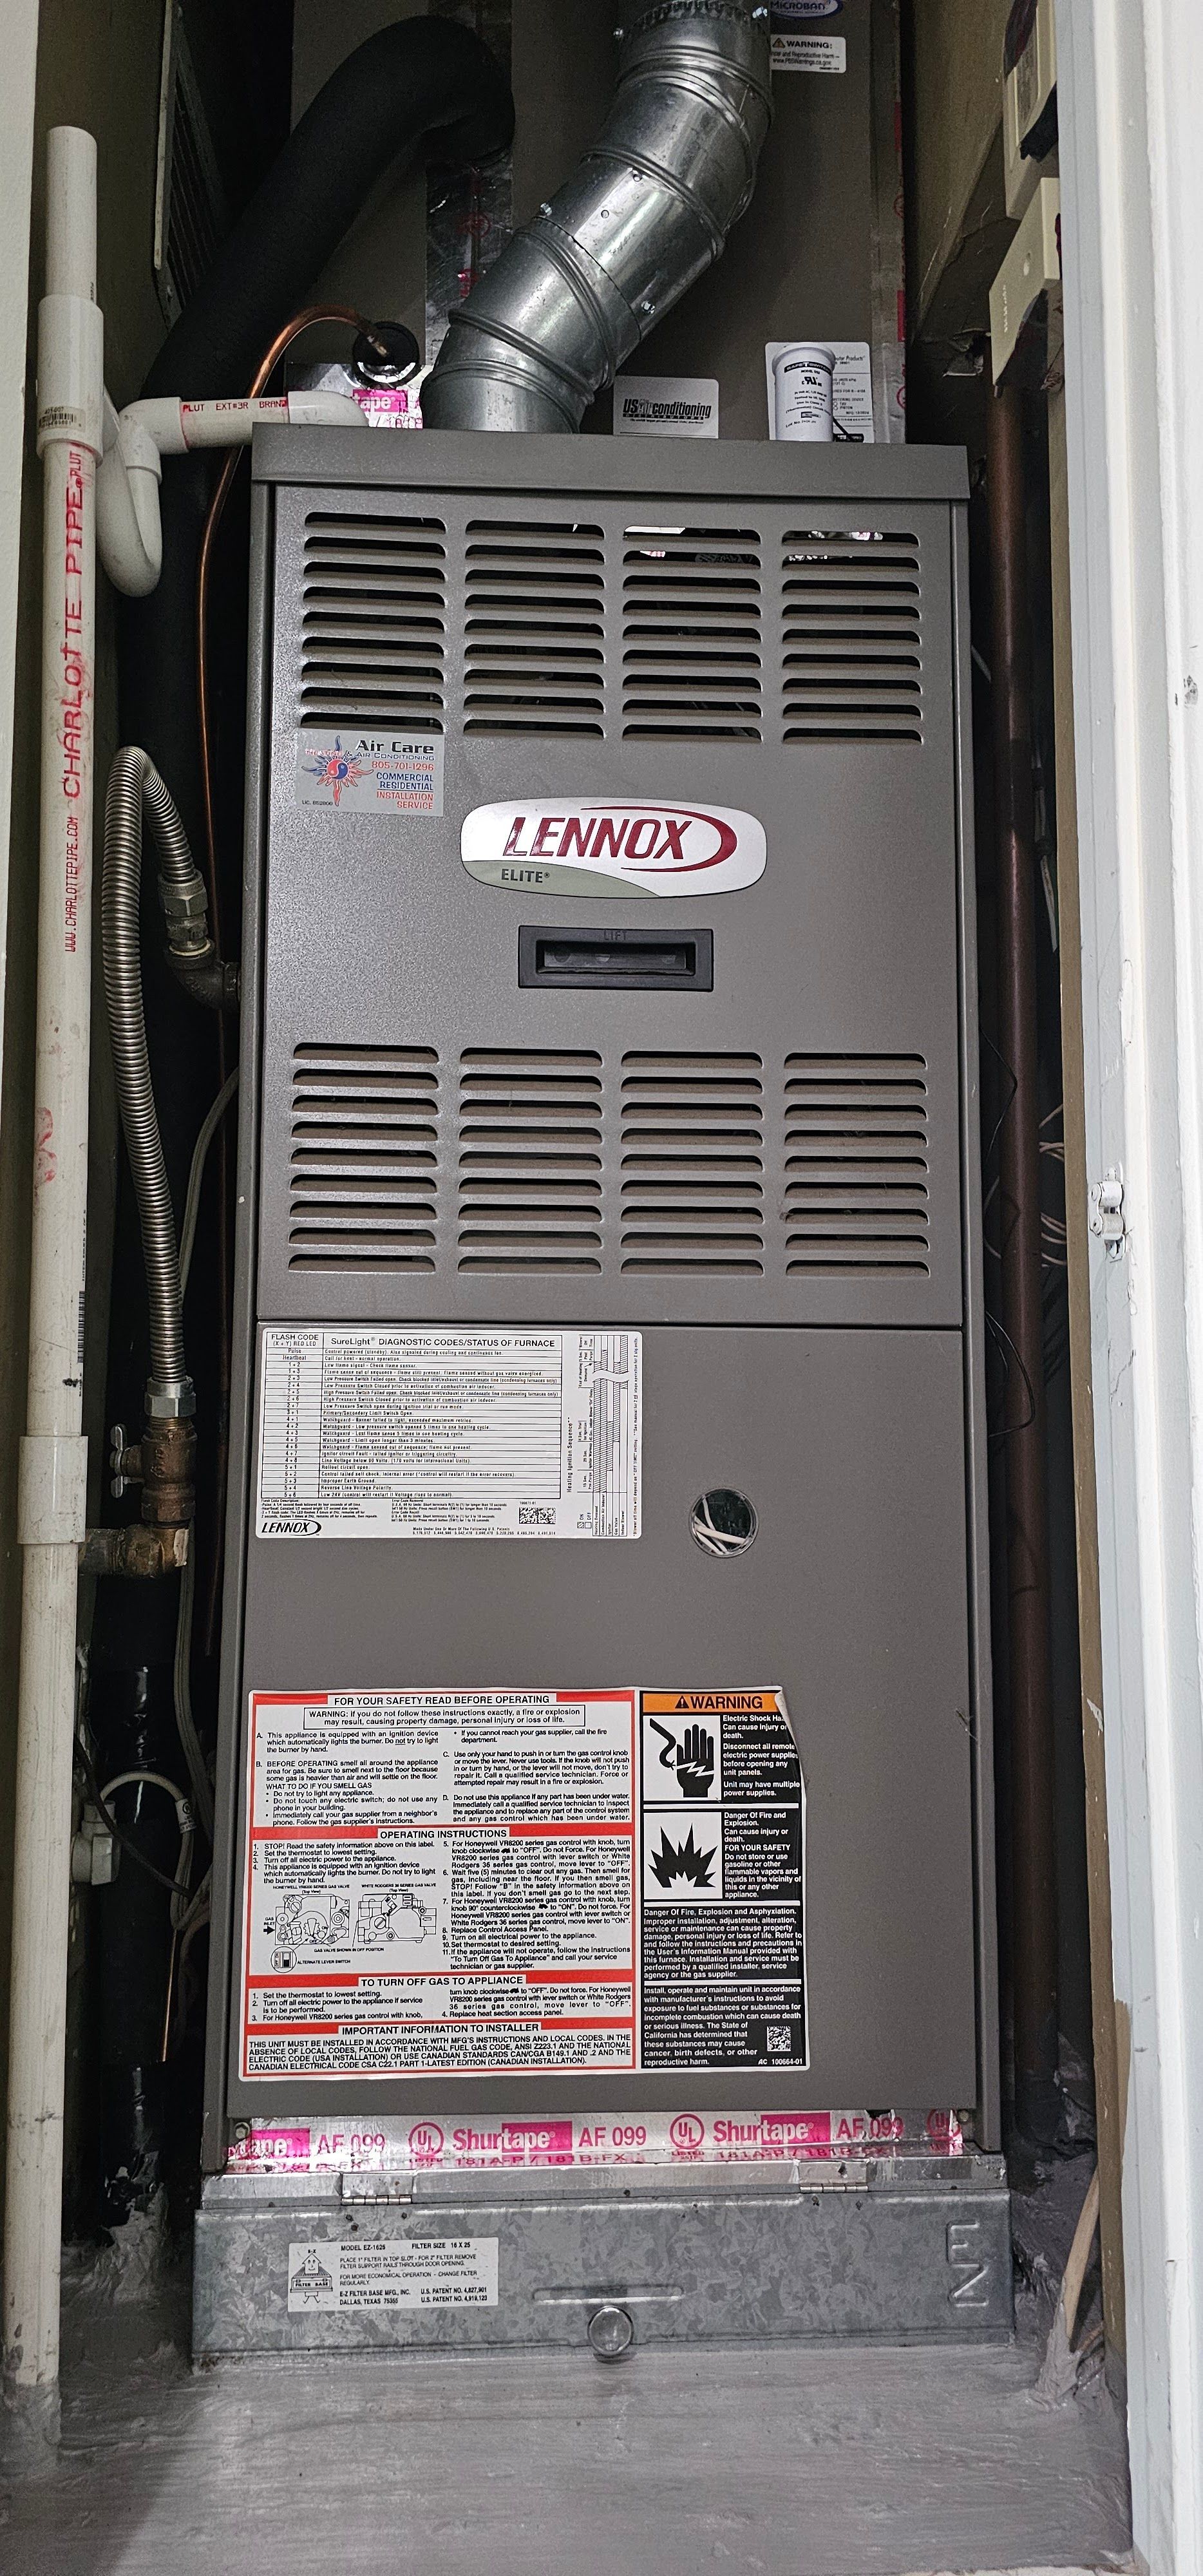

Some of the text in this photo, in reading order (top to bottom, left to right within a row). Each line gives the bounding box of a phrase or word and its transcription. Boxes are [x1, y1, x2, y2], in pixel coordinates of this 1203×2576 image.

[786, 41, 832, 49] WARNING:
[183, 404, 205, 412] PLUT
[63, 598, 82, 798] CHARLOTTE
[355, 740, 434, 753] Air Care
[374, 752, 435, 761] CONDITIONING
[372, 761, 434, 771] 805-701-1296
[376, 772, 433, 782] COMMERCIAL
[379, 781, 433, 790] RESIDENTIAL
[377, 791, 433, 801] INSTALLATION
[397, 801, 433, 810] SERVICE
[502, 817, 692, 860] LENNOX
[65, 816, 78, 952] WWW.CHARLOTTEPIPE.COM
[603, 929, 629, 941] LIFT
[261, 1522, 310, 1533] LENNOX
[690, 1696, 763, 1709] WARNING
[488, 1709, 514, 1718] exactly,
[366, 1718, 394, 1727] causing
[760, 1723, 779, 1732] injury
[437, 1830, 507, 1838] INSTRUCTIONS
[468, 1976, 523, 1985] APPLIANCE
[342, 2027, 399, 2035] IMPORTANT
[401, 2025, 468, 2034] INFORMATION
[486, 2023, 538, 2032] INSTALLER
[350, 2133, 386, 2153] 099
[578, 2127, 607, 2147] AF
[612, 2126, 646, 2146] 099
[837, 2117, 864, 2139] AF
[870, 2116, 904, 2139] 099
